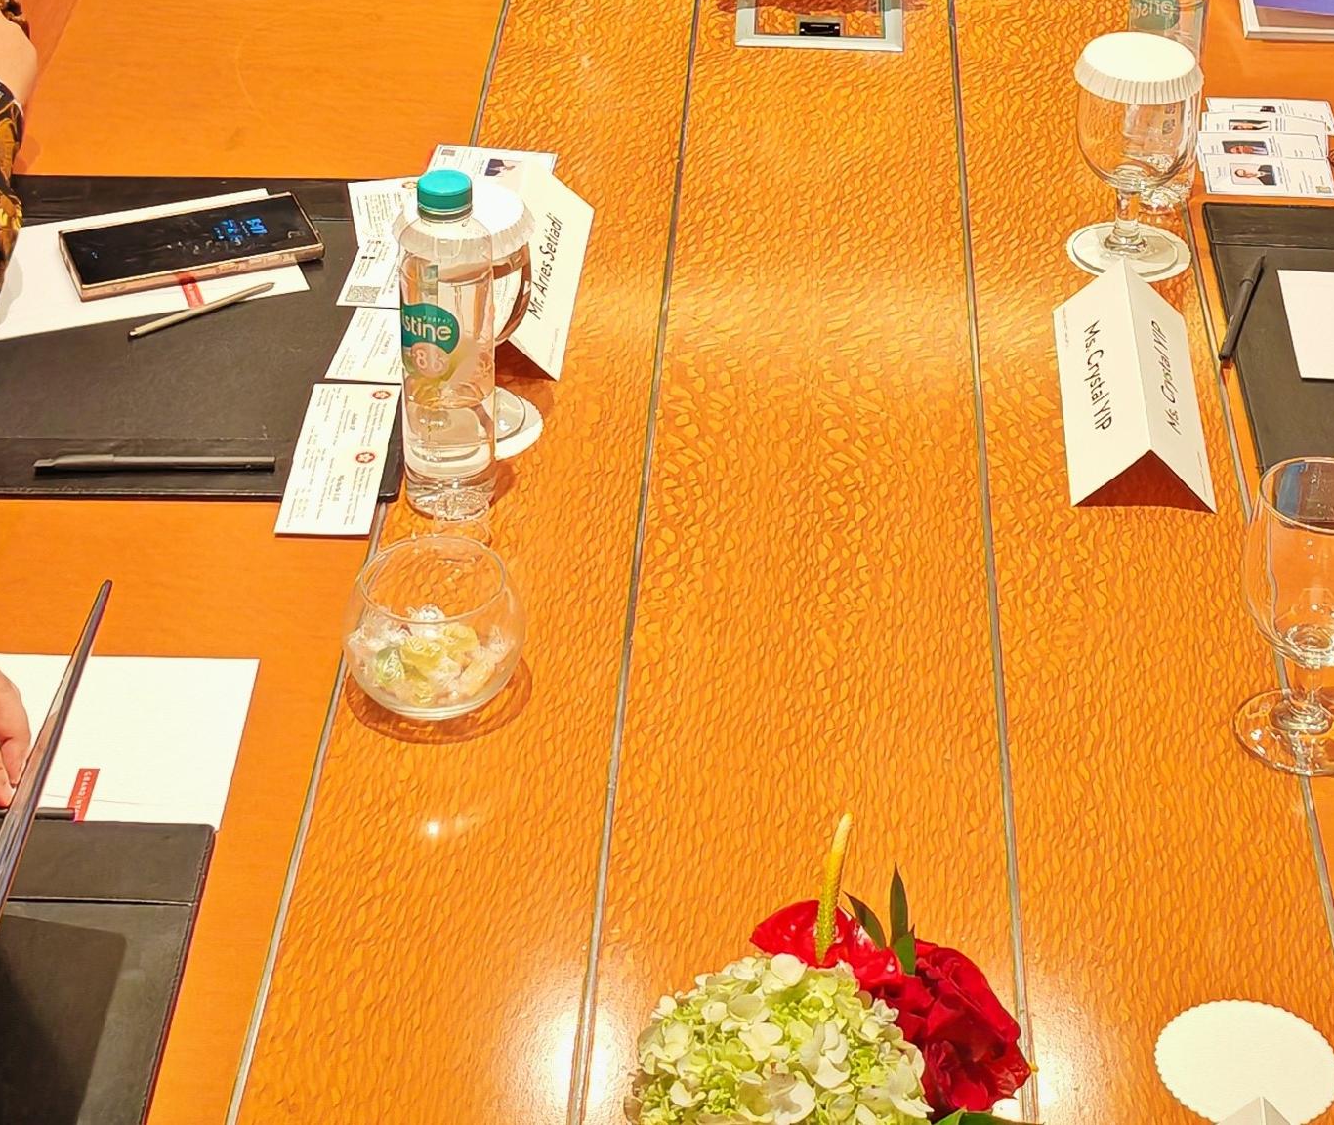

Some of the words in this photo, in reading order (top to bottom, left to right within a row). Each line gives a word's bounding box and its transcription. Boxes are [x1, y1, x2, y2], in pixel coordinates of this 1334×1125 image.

[539, 212, 563, 262] Setiadi
[532, 260, 553, 298] Aries
[527, 297, 545, 321] Mr.
[402, 315, 453, 343] stine
[1084, 319, 1101, 352] Ms.
[1151, 319, 1168, 351] YIP
[1084, 349, 1110, 406] Crystal
[1154, 345, 1179, 404] Crystal
[1094, 399, 1112, 430] YIP
[1165, 408, 1182, 436] Ms.
